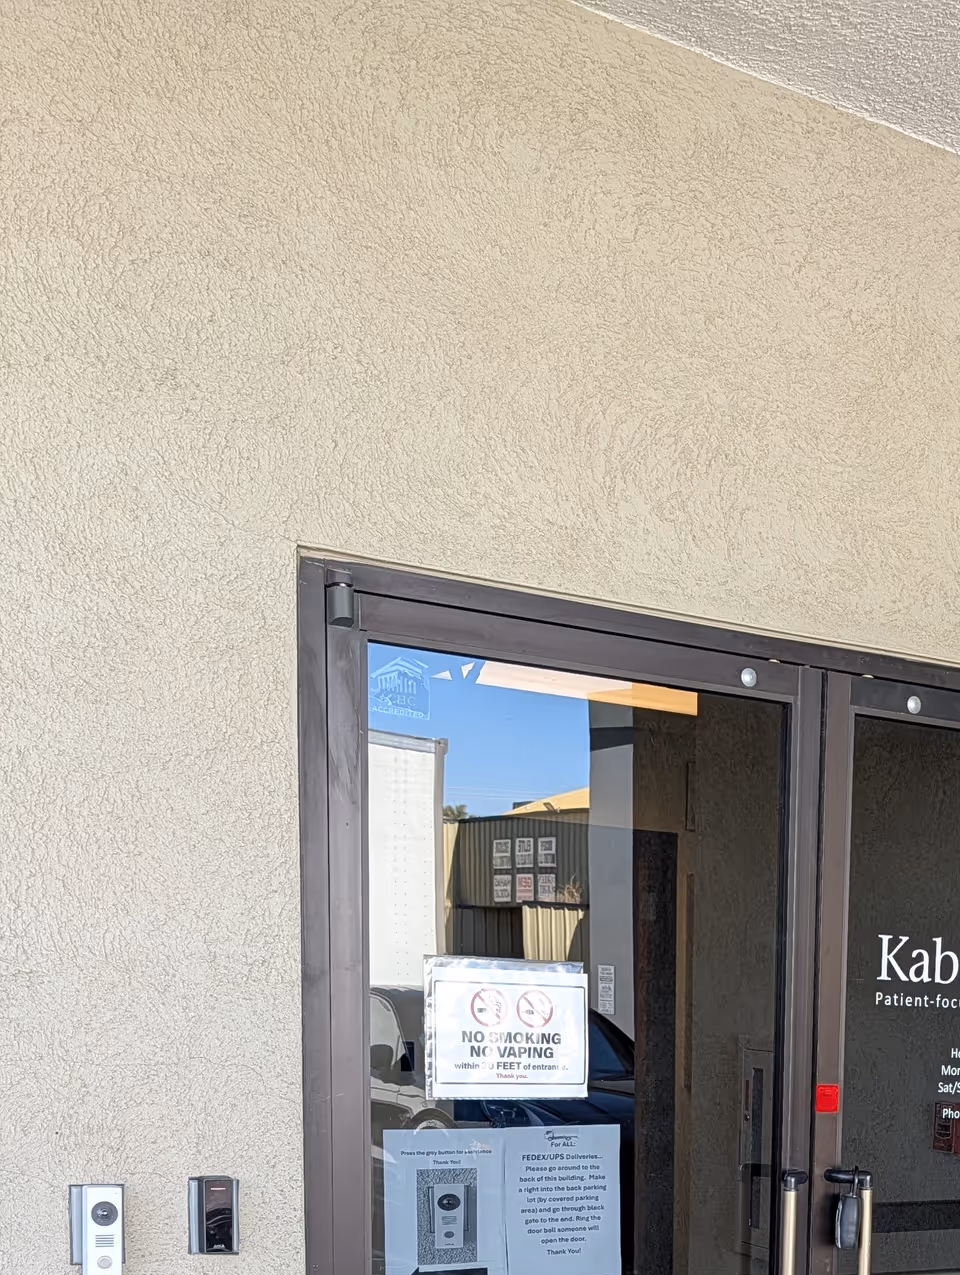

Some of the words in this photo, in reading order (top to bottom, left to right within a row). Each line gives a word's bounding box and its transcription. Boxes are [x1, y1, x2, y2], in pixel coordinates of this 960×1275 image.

[461, 1030, 485, 1044] NO
[488, 1031, 562, 1045] SMOKING
[470, 1045, 493, 1058] NO
[497, 1046, 554, 1059] VAPING
[454, 1062, 480, 1070] within
[496, 1061, 522, 1070] FEET
[523, 1062, 531, 1070] of
[515, 1073, 529, 1081] you.
[522, 1153, 565, 1161] FEDEX/UPS
[558, 1174, 587, 1182] building.
[523, 1186, 539, 1194] right
[583, 1184, 607, 1192] parking
[536, 1196, 547, 1204] (by
[575, 1194, 599, 1202] parking
[561, 1205, 587, 1213] through
[527, 1227, 543, 1235] door
